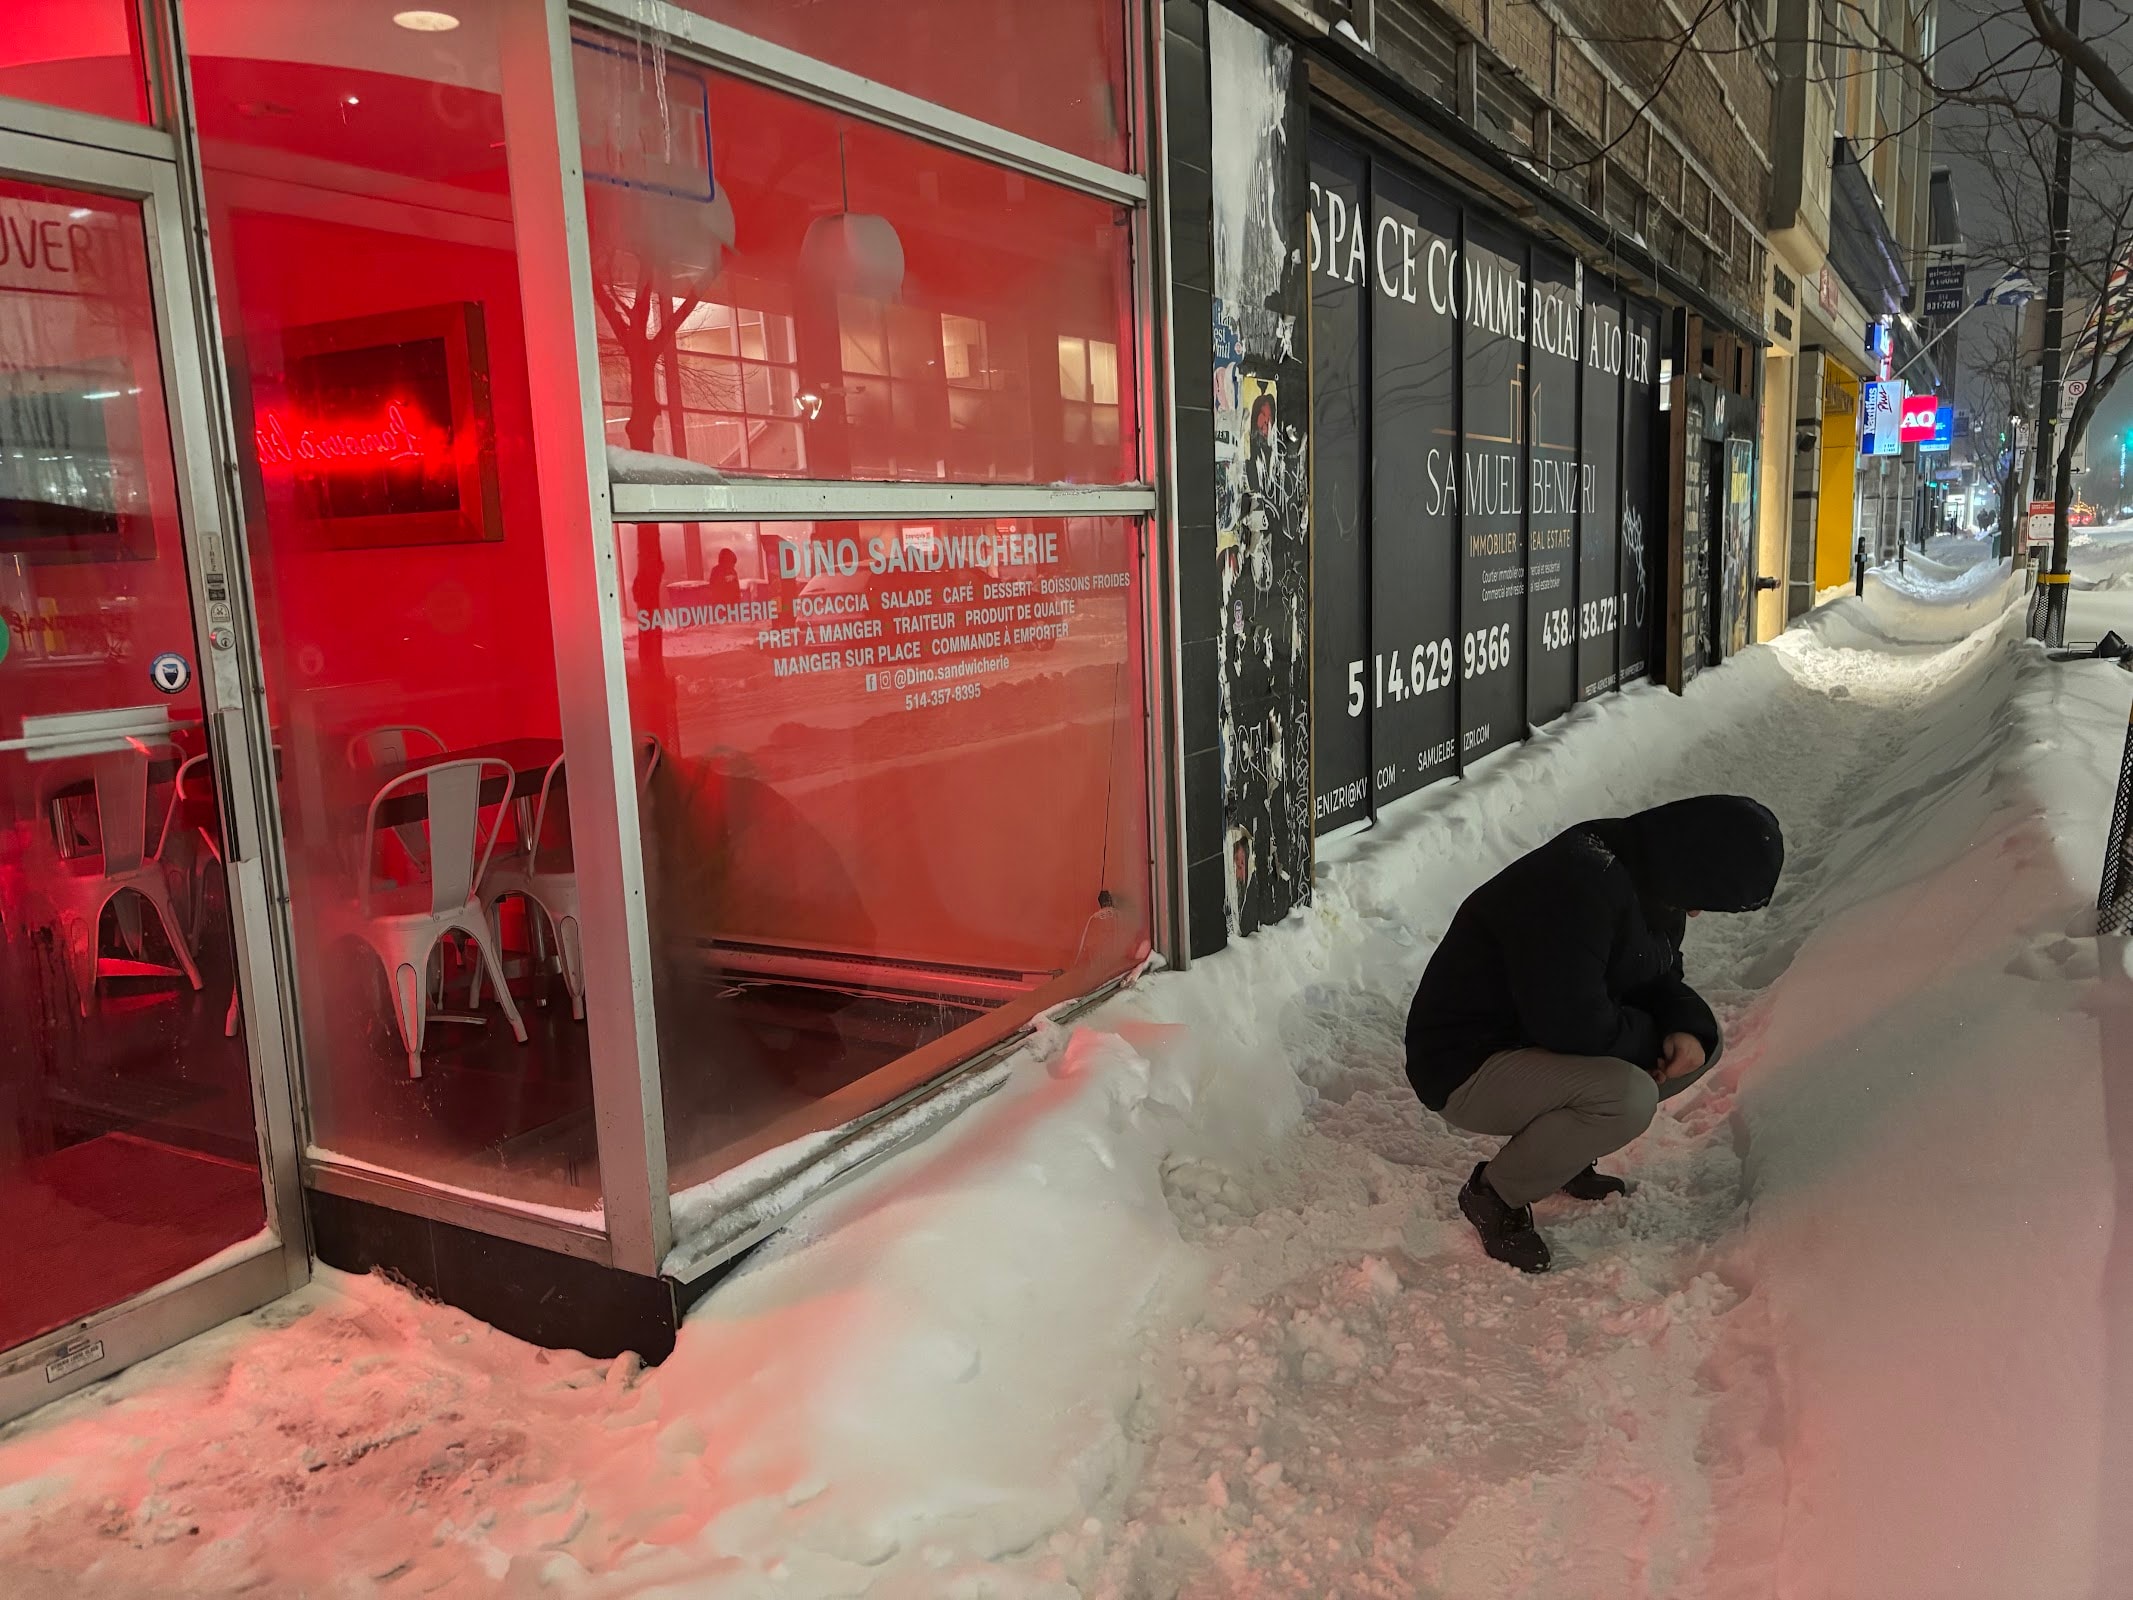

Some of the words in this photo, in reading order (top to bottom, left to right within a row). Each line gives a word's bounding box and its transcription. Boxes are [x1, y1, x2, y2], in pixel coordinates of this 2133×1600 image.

[1589, 301, 1600, 370] À
[1603, 320, 1650, 385] LOUER
[1426, 448, 1522, 516] SAMUEL
[1532, 458, 1596, 514] BENIZRI
[778, 537, 859, 580] DINO
[868, 532, 1059, 575] SANDWICHERIE
[1470, 532, 1517, 557] IMMOBILIER
[1531, 530, 1545, 551] EAL
[1547, 528, 1571, 549] ESTATE
[637, 599, 779, 631] SANDWICHERIE
[792, 593, 870, 618] FOCACCIA
[881, 588, 932, 610] SALADE
[943, 581, 973, 604] CAFÉ
[983, 580, 1032, 600] DESSERT
[1041, 576, 1091, 595] BOISSONS
[1092, 572, 1131, 590] FROIDES
[758, 628, 800, 650] PRET
[805, 622, 816, 645] À
[819, 620, 882, 643] MANGER
[893, 613, 956, 635] TRAITEUR
[965, 606, 1015, 627] PRODUIT
[1018, 604, 1032, 620] DE
[1033, 597, 1075, 618] QUALITÉ
[1542, 593, 1628, 652] 438.38.721
[773, 654, 842, 677] MANGER
[845, 647, 875, 668] SUR
[878, 642, 921, 664] PLACE
[931, 633, 1001, 655] COMMANDE
[1003, 625, 1012, 646] À
[1013, 623, 1069, 645] EMPORTER
[894, 655, 1010, 690] @Dino.sandwicherie
[1347, 622, 1511, 718] 514.6299366
[905, 683, 981, 711] 514-357-8395
[1417, 722, 1490, 772] SAMUELBEIZRI.COM
